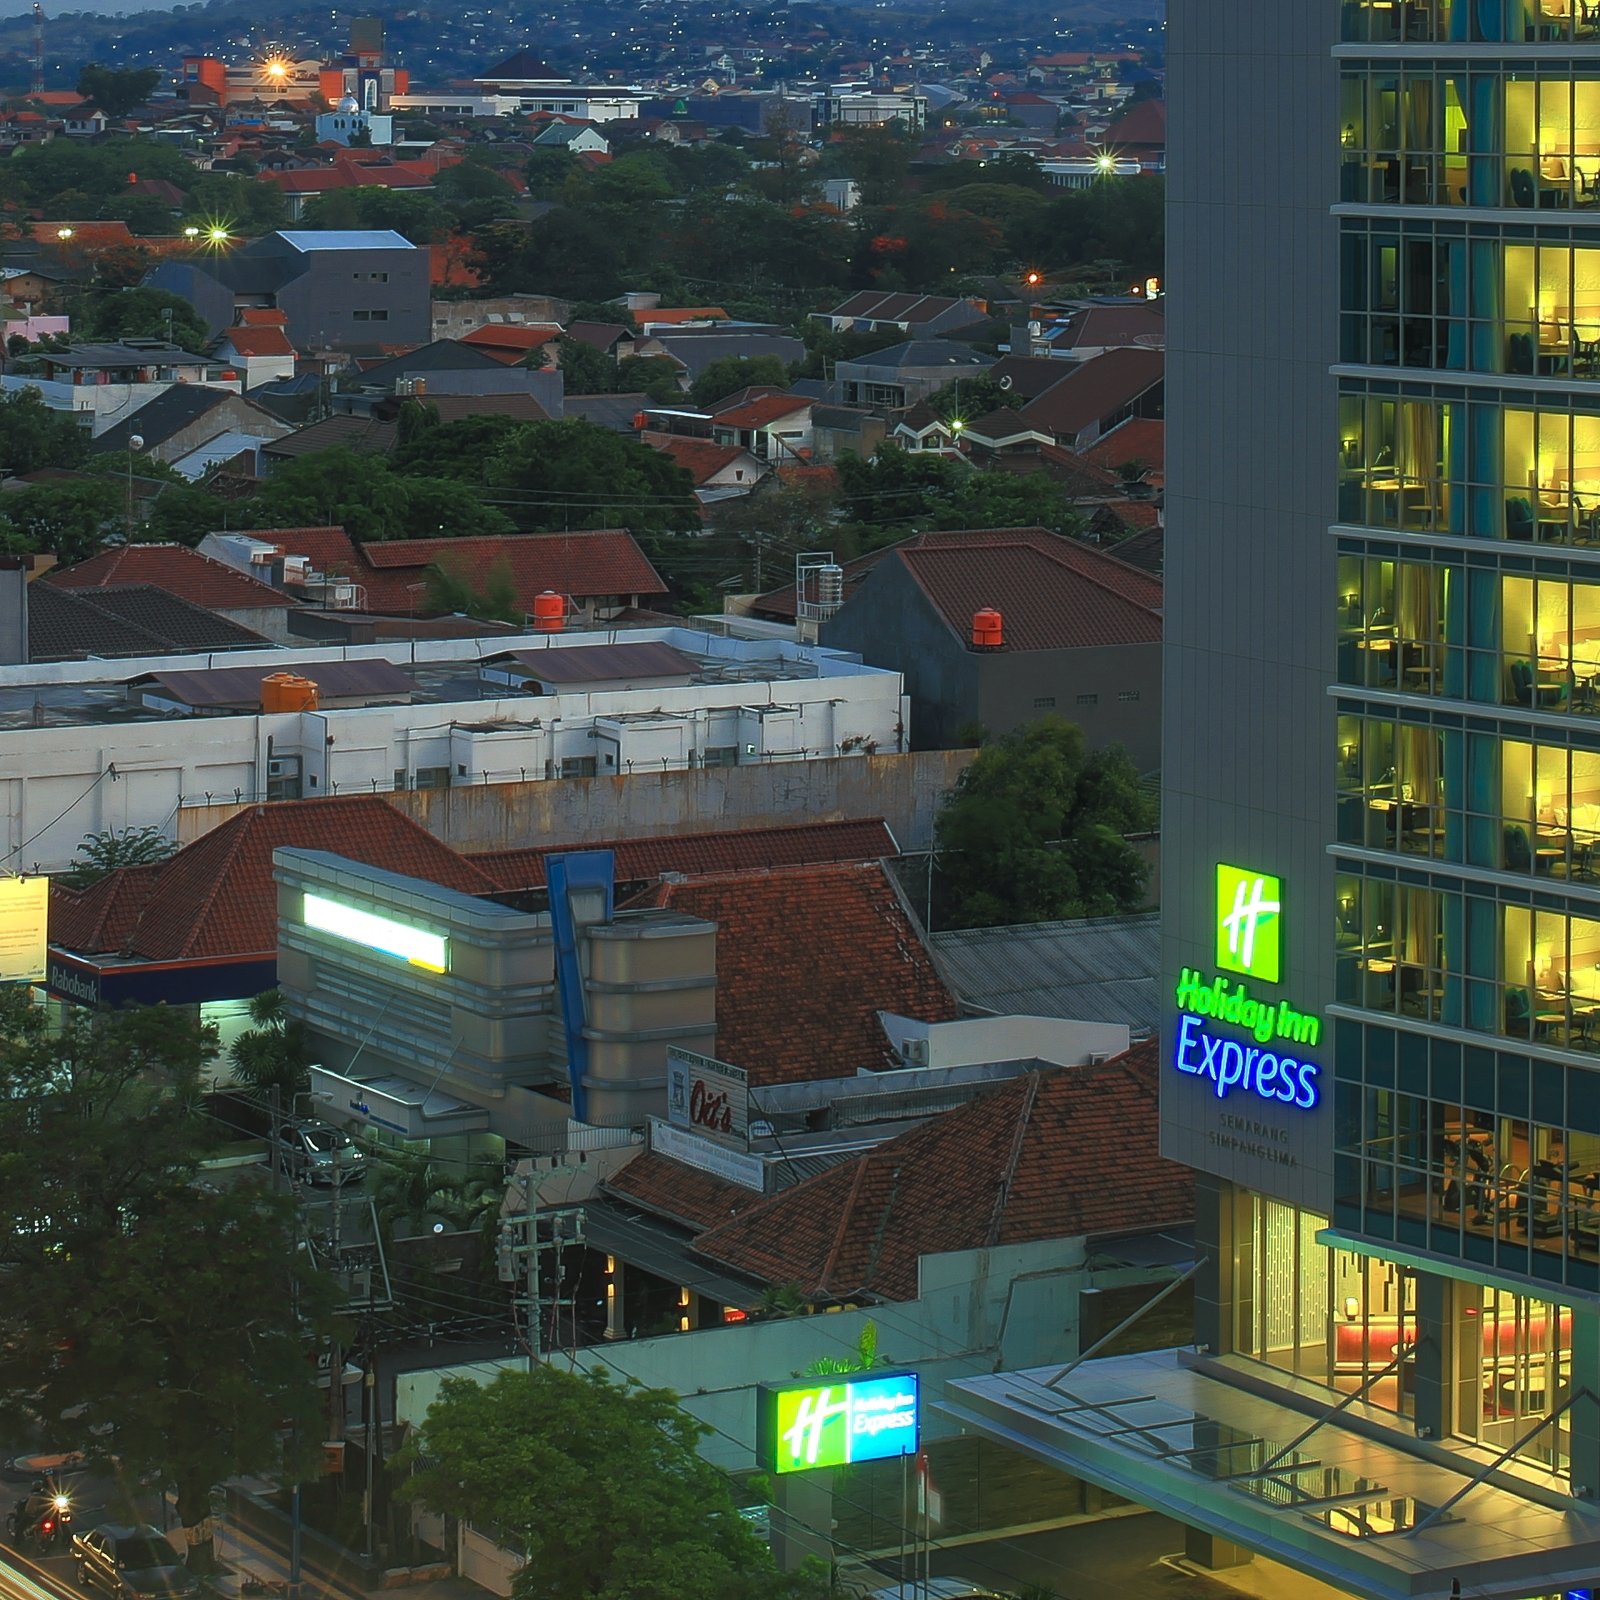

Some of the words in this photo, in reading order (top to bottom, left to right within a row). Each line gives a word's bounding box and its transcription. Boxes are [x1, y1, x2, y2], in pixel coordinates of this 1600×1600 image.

[51, 965, 97, 1003] Rabobank
[1177, 967, 1276, 1043] Holiday
[1276, 1000, 1321, 1047] Inn
[1176, 1013, 1320, 1110] Express
[1220, 1112, 1288, 1145] SEMARANG
[854, 1409, 915, 1435] Express
